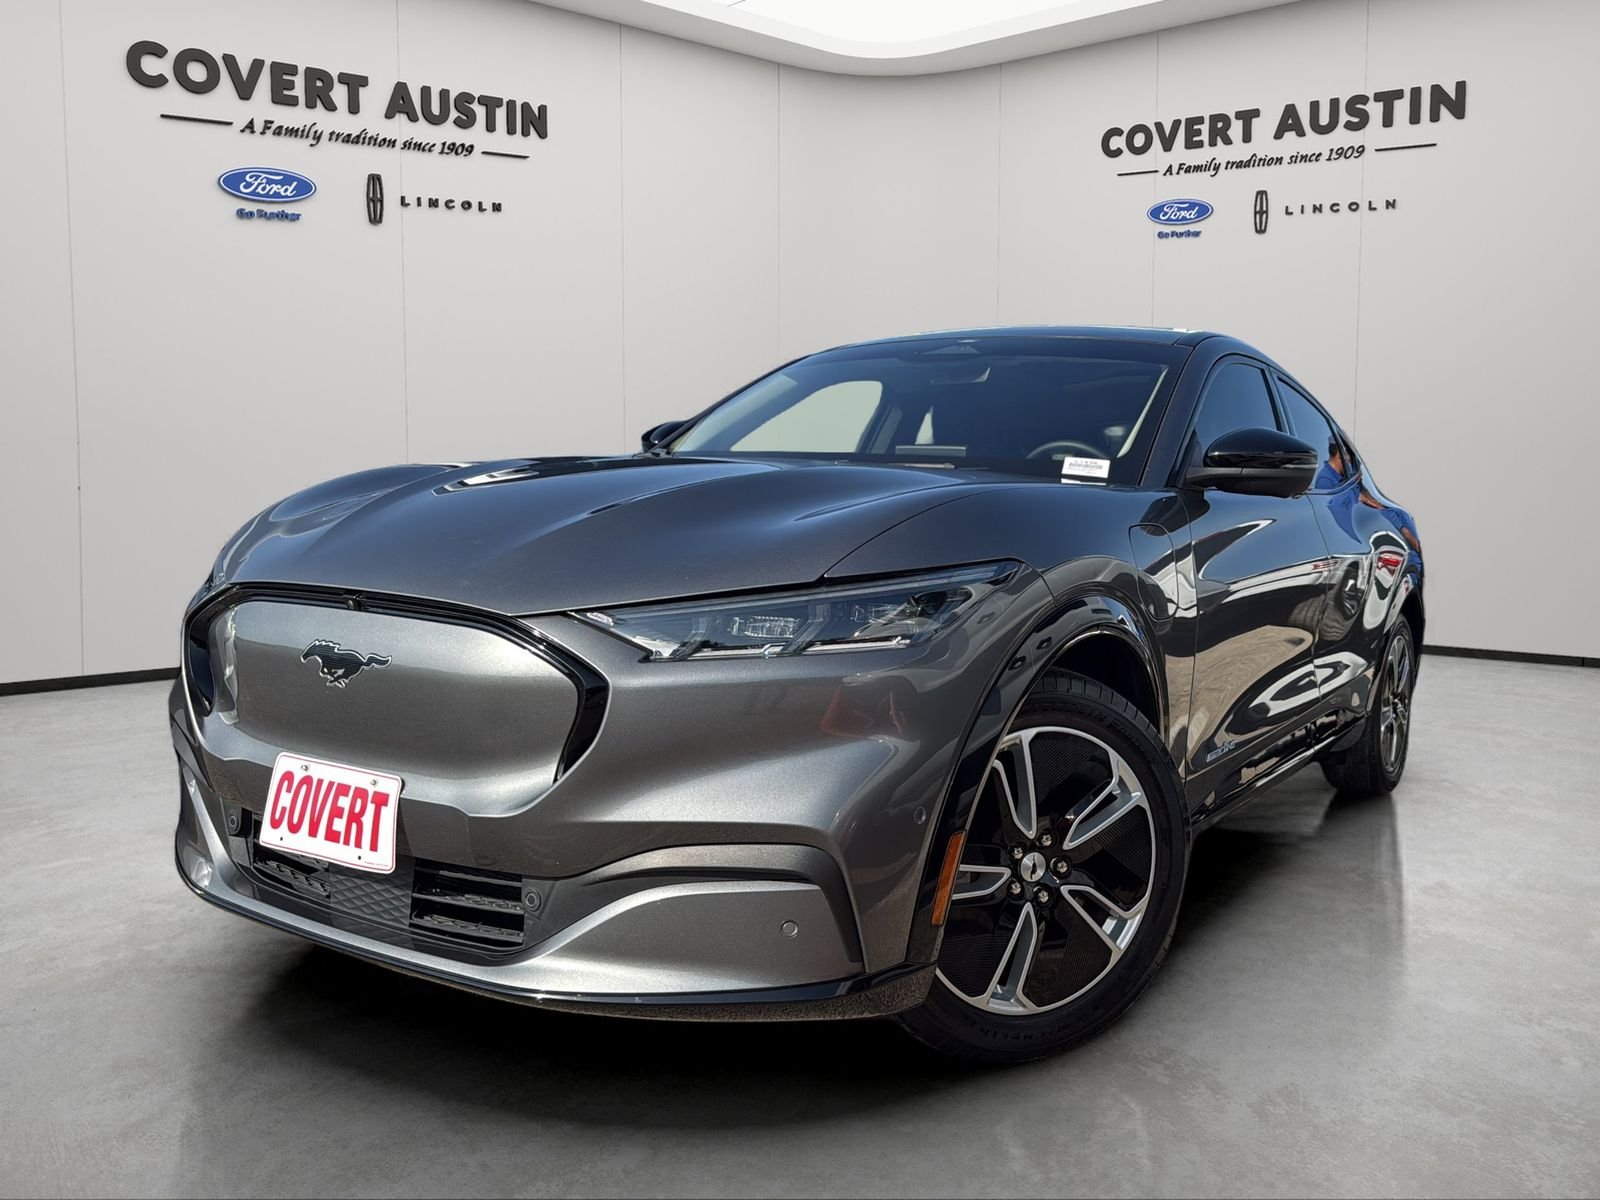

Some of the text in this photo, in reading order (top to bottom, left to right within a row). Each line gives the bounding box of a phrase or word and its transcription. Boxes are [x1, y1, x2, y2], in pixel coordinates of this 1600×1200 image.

[126, 40, 548, 139] COVERT AUSTIN
[1101, 80, 1467, 158] COVERT AUSTIN
[239, 117, 475, 157] A Family tradition since 1909
[1162, 144, 1366, 178] A Family tradition since 1909
[239, 171, 298, 196] Ford
[400, 195, 503, 213] LINCOLN
[1160, 203, 1199, 220] Ford
[1284, 198, 1397, 216] LINCOLN
[269, 770, 390, 852] COVERT
